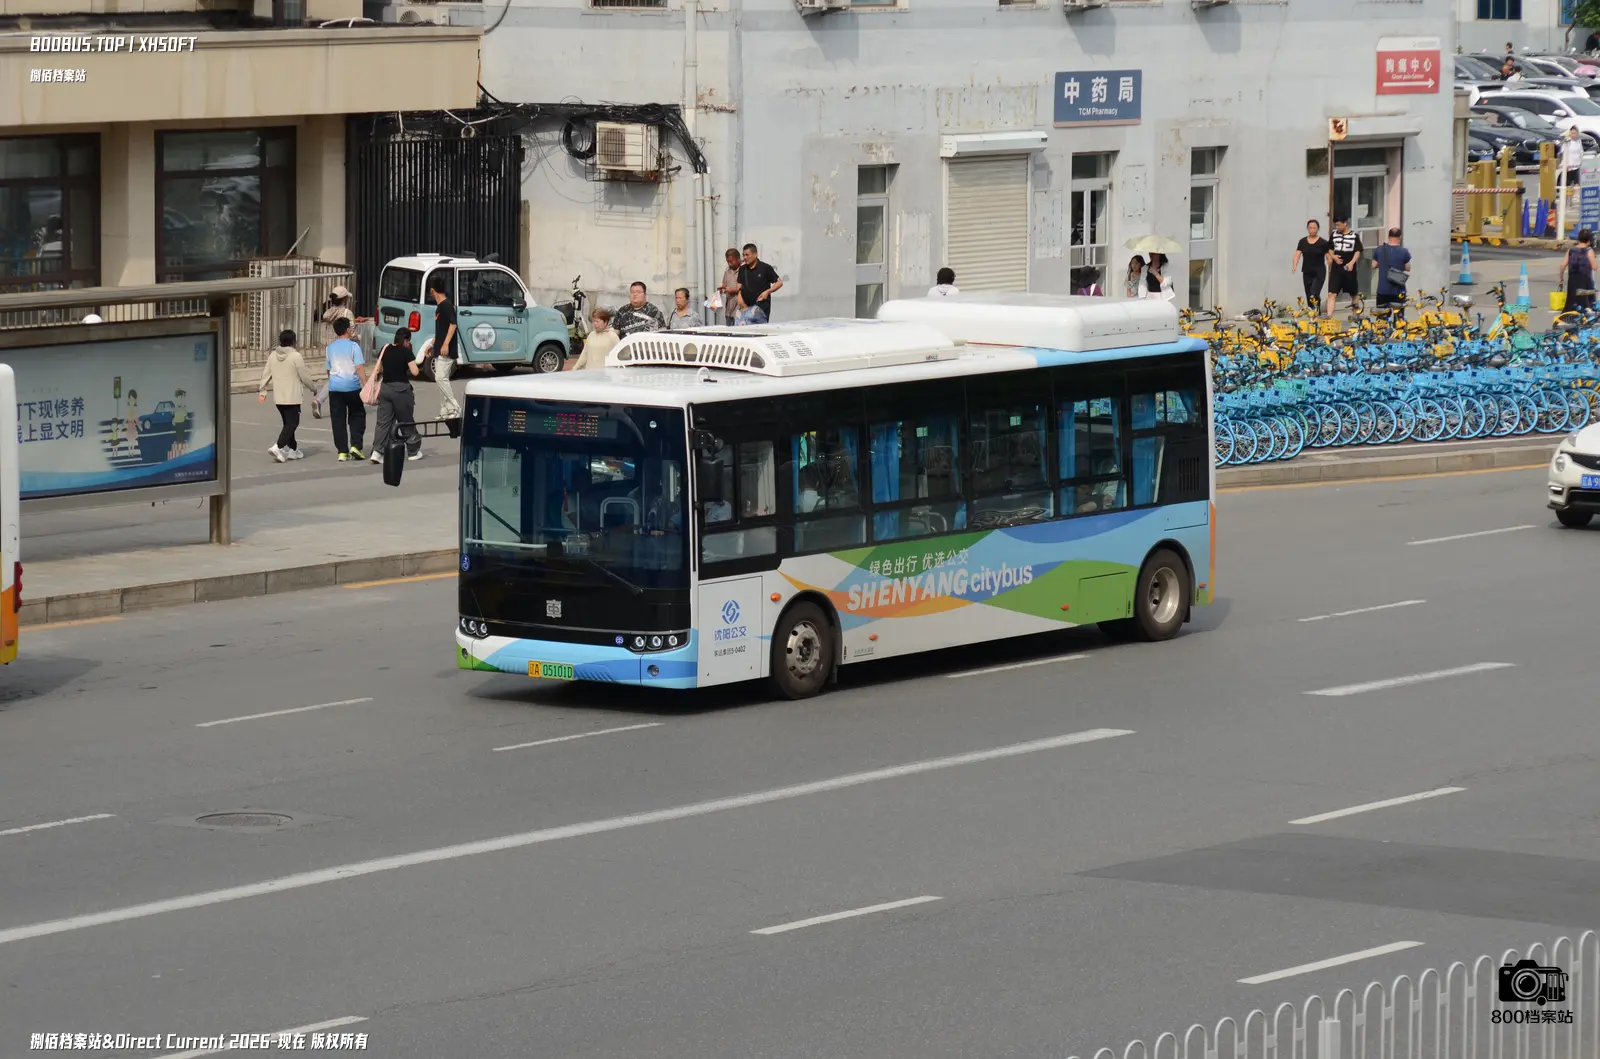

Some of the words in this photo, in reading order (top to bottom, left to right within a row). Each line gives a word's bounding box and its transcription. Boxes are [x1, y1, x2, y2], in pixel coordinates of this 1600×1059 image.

[1064, 76, 1134, 105] 中药局
[1078, 108, 1091, 116] TCM
[1091, 107, 1118, 116] Pharmacy
[869, 556, 918, 577] 绿色出行
[922, 548, 969, 569] 优选公交
[847, 568, 969, 611] SHENYANG
[970, 562, 1033, 596] citybus
[714, 626, 747, 641] 沈阳公交
